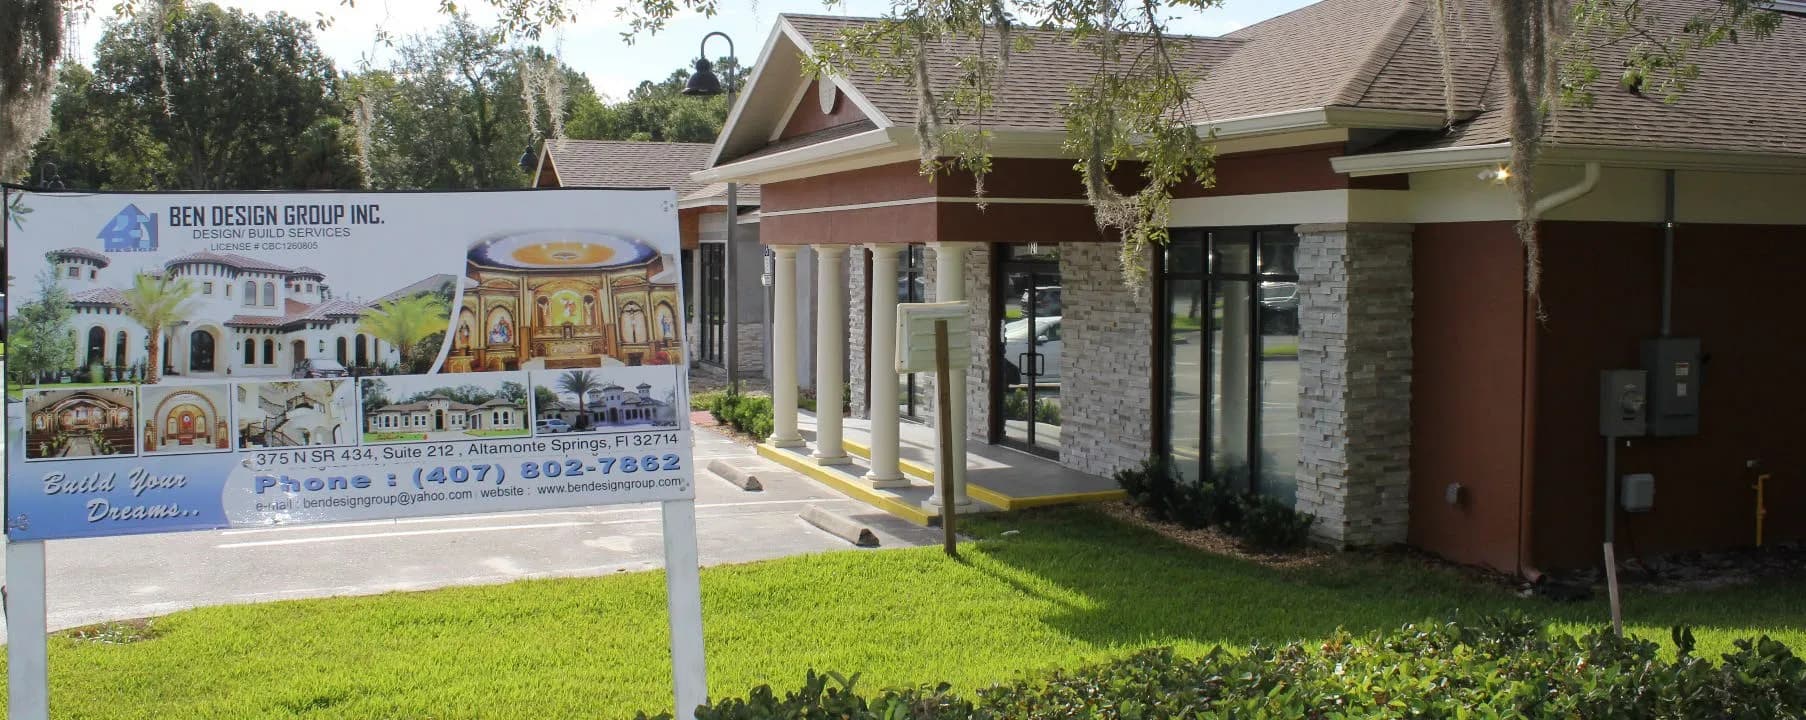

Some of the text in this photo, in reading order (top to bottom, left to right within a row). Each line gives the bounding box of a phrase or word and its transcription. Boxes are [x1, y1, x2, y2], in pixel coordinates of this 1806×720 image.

[169, 206, 205, 227] BEN
[212, 205, 278, 226] DESIGN
[284, 204, 345, 225] GROUP
[351, 204, 385, 225] INC.
[193, 227, 351, 239] DESIGN/ BUILD SERVICES
[211, 241, 318, 251] LICENSE # CBC1260805
[257, 453, 289, 465] 375
[294, 452, 306, 464] N
[311, 450, 334, 463] SR
[341, 448, 377, 461] 434,
[383, 446, 422, 460] Suite
[427, 445, 454, 457] 212
[468, 440, 546, 455] Altamonte
[551, 437, 611, 453] Springs,
[633, 433, 679, 446] 32714
[44, 467, 187, 496] Build Your
[255, 453, 680, 494] Phone : (407) 802-7862
[303, 490, 472, 510] bendesigngroup@yahoo.com
[481, 486, 524, 498] website
[537, 477, 681, 496] www.bendesigngroup.com
[87, 497, 199, 522] Dreams..
